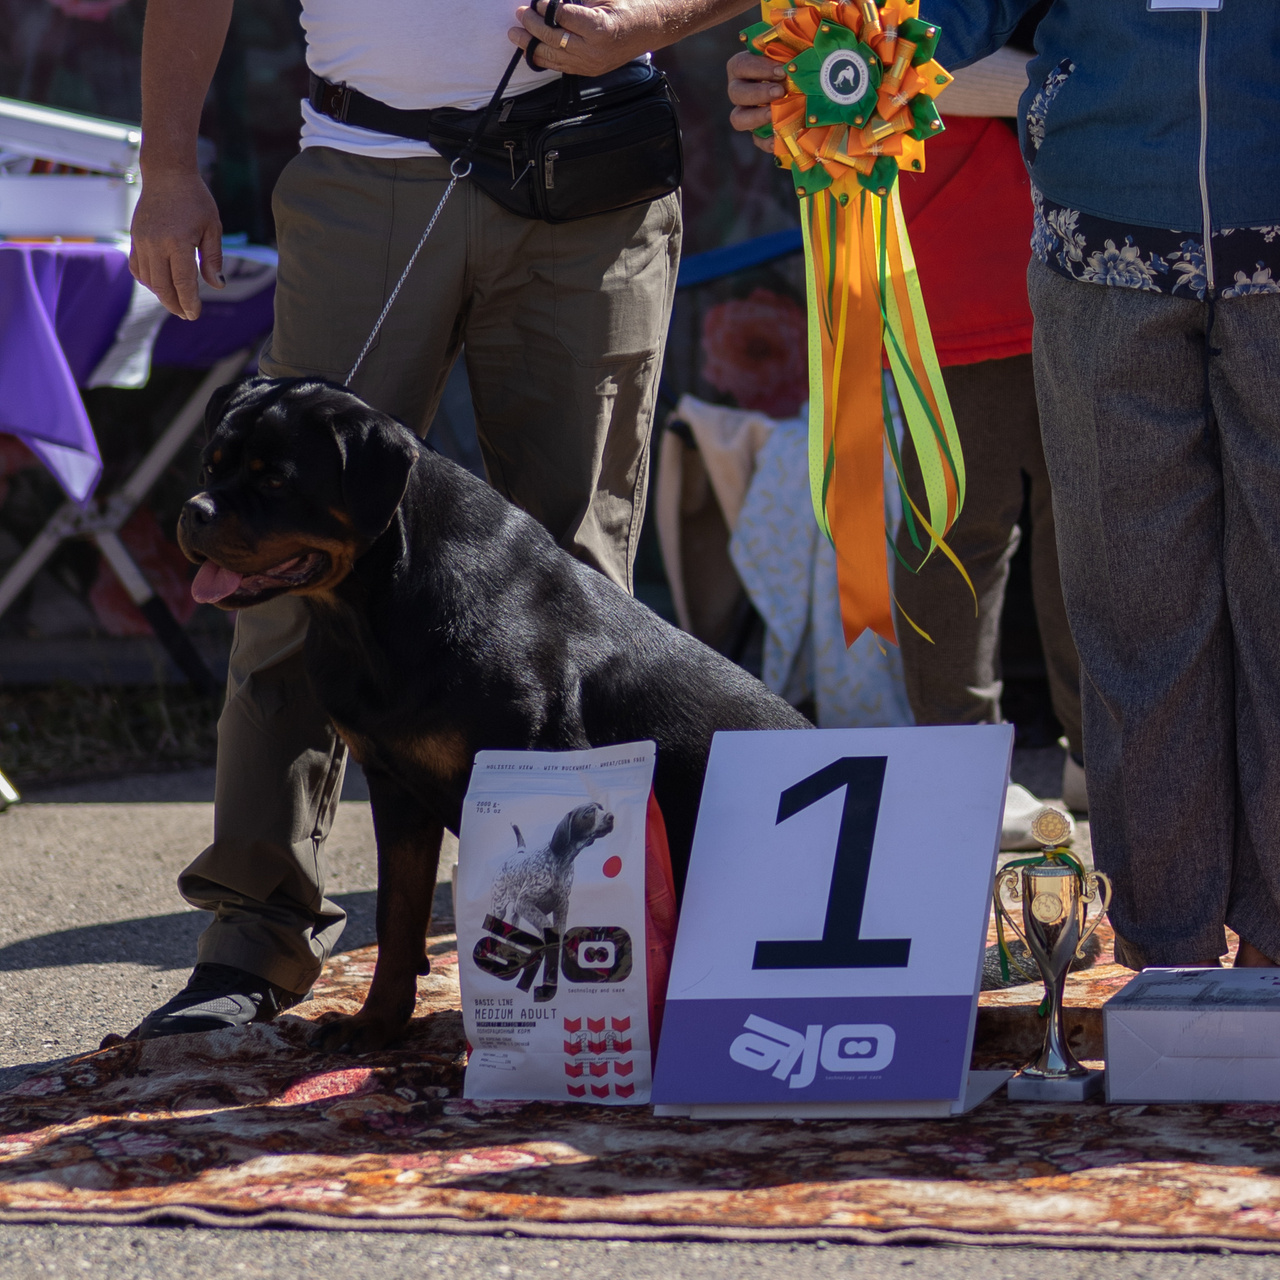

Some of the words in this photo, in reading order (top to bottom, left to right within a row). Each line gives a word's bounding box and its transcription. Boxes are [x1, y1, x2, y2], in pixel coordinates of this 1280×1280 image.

[752, 756, 912, 970] 1
[475, 1009, 513, 1019] MEDIUM
[520, 1009, 557, 1019] ADULT
